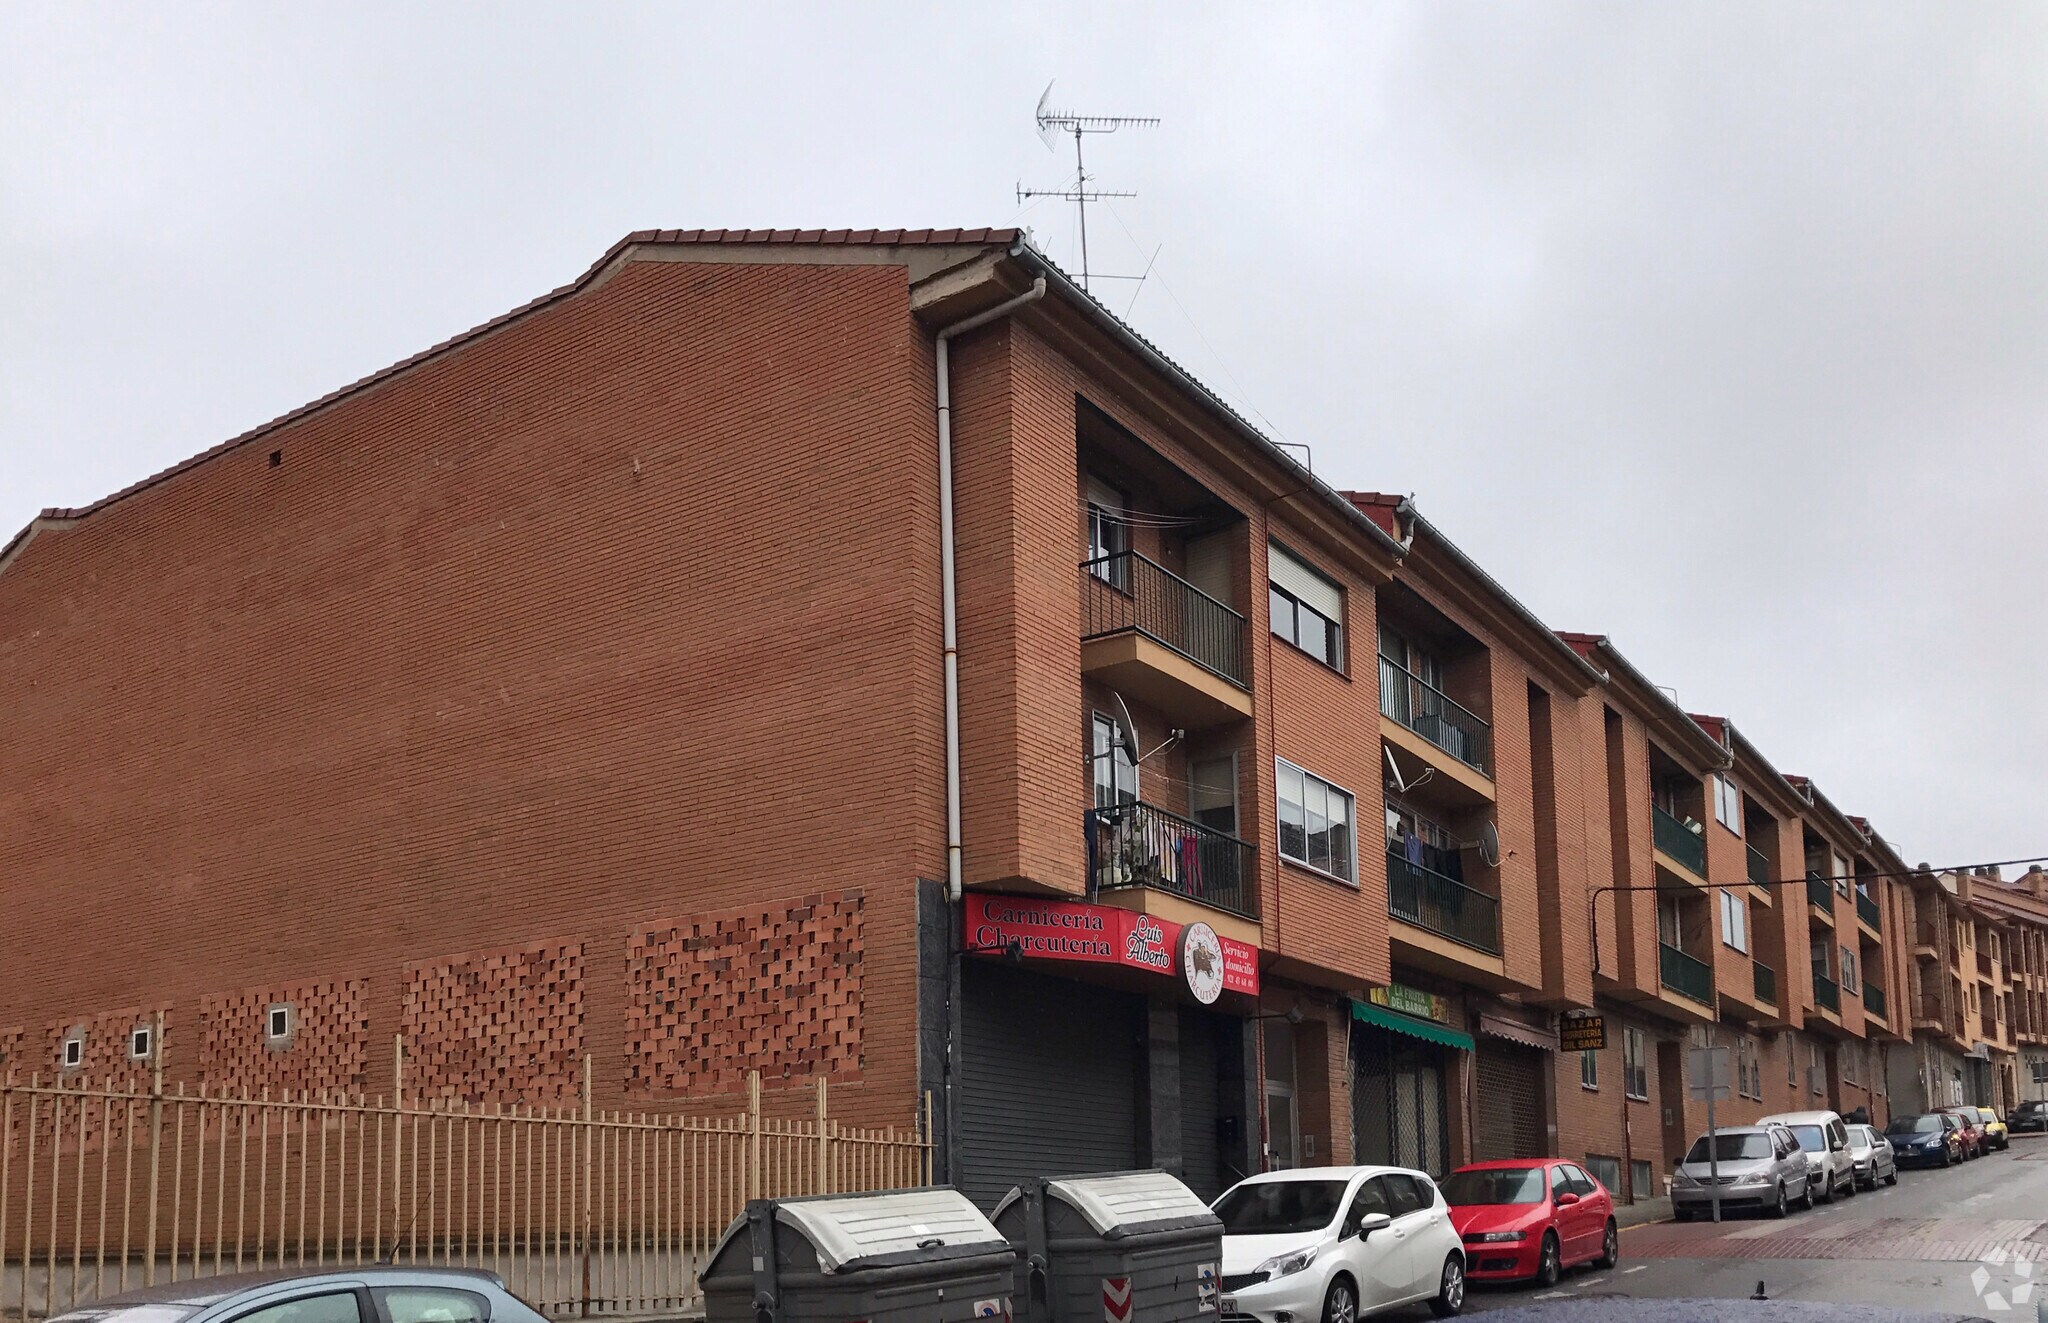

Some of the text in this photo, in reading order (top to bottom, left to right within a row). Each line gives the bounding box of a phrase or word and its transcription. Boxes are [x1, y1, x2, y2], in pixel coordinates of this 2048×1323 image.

[983, 900, 1104, 930] Carnicería
[1131, 915, 1163, 944] Luis
[976, 925, 1111, 956] Charcutería
[1126, 935, 1170, 968] Alberto
[1223, 941, 1249, 960] Servicio
[1225, 957, 1254, 976] domicilio
[1394, 985, 1425, 1004] LA FRUTA
[1391, 996, 1429, 1016] DEL BARRIO
[1562, 1018, 1602, 1029] BAZAR
[1578, 1039, 1602, 1049] SANZ
[1221, 1301, 1235, 1312] CX
